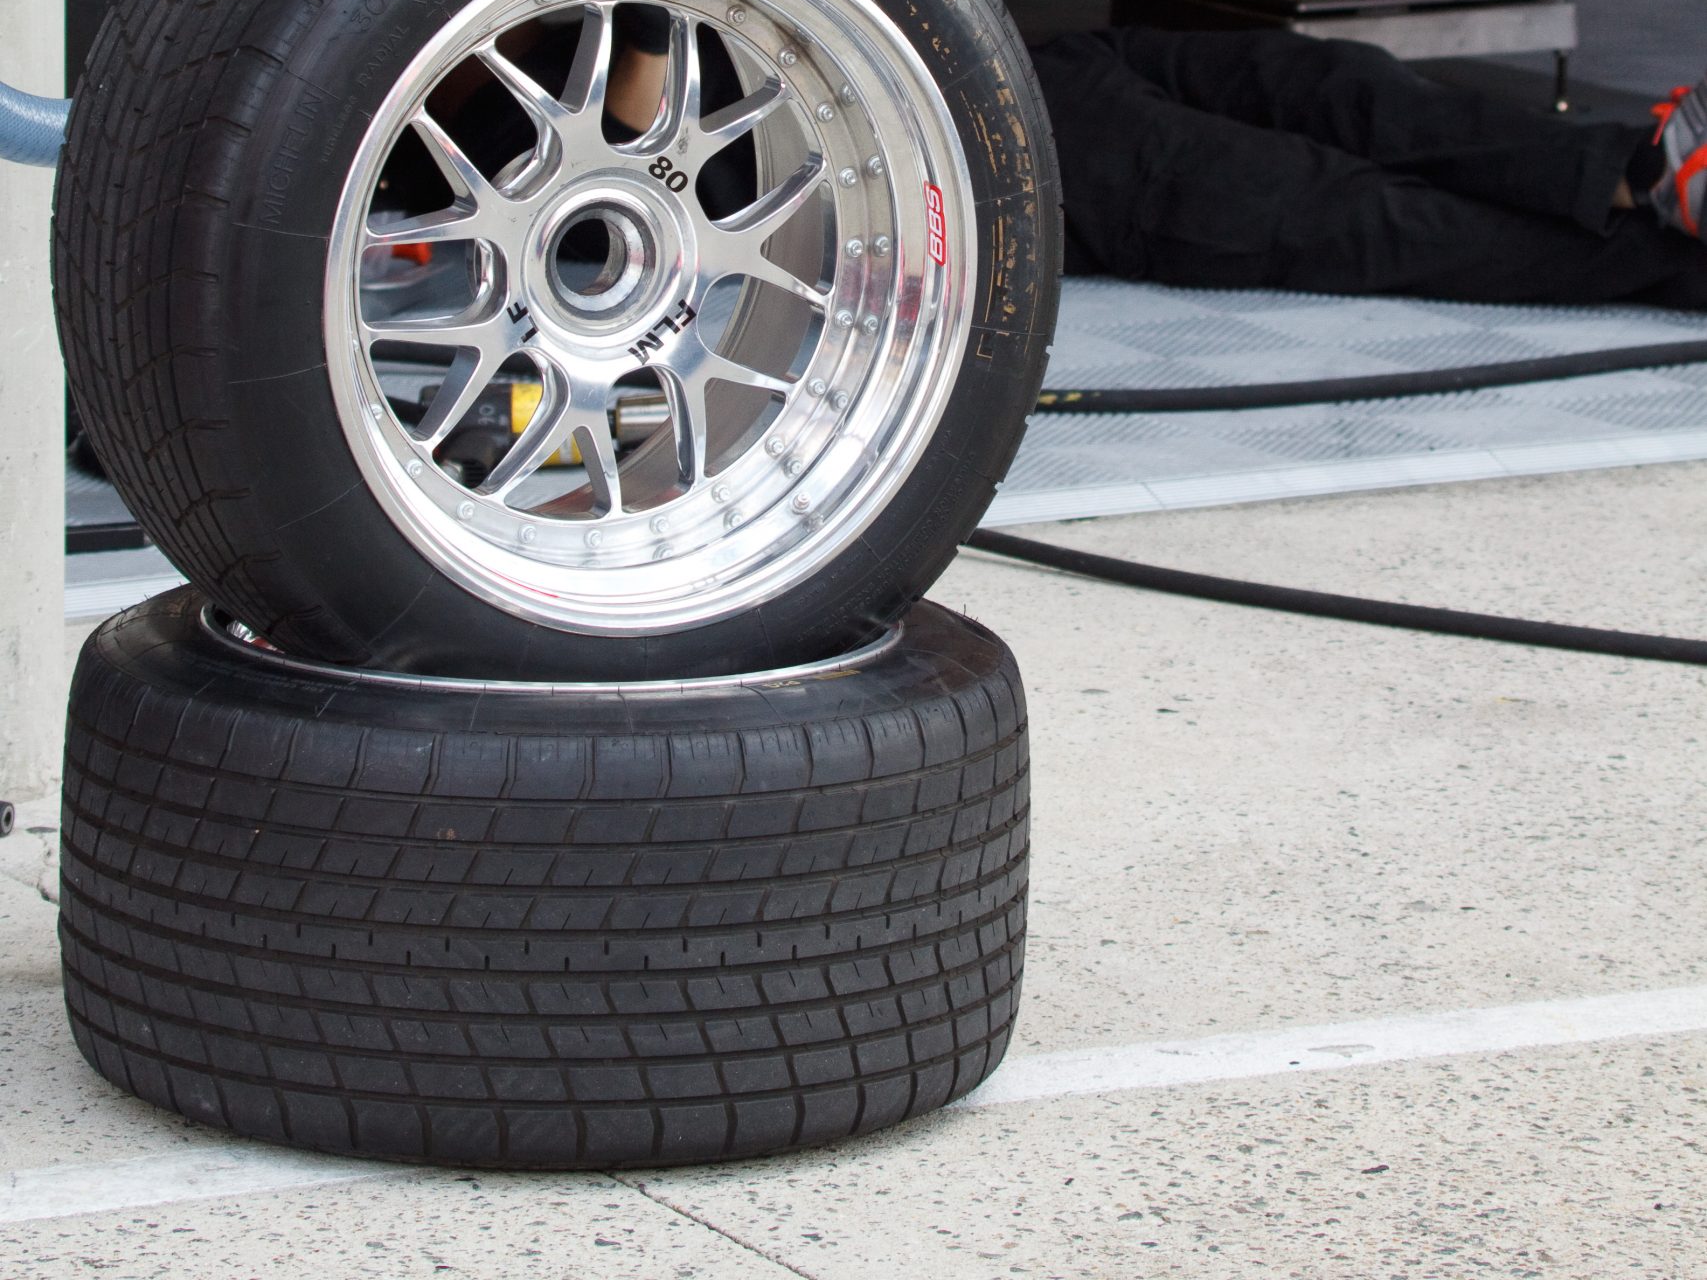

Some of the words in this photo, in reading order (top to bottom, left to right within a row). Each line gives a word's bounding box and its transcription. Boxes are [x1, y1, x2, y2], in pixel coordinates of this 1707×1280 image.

[357, 22, 411, 88] RADIAL
[261, 90, 323, 225] MICHELIN
[648, 156, 689, 193] 80
[925, 185, 943, 263] BBS
[506, 302, 540, 343] LF
[627, 299, 698, 366] FLM
